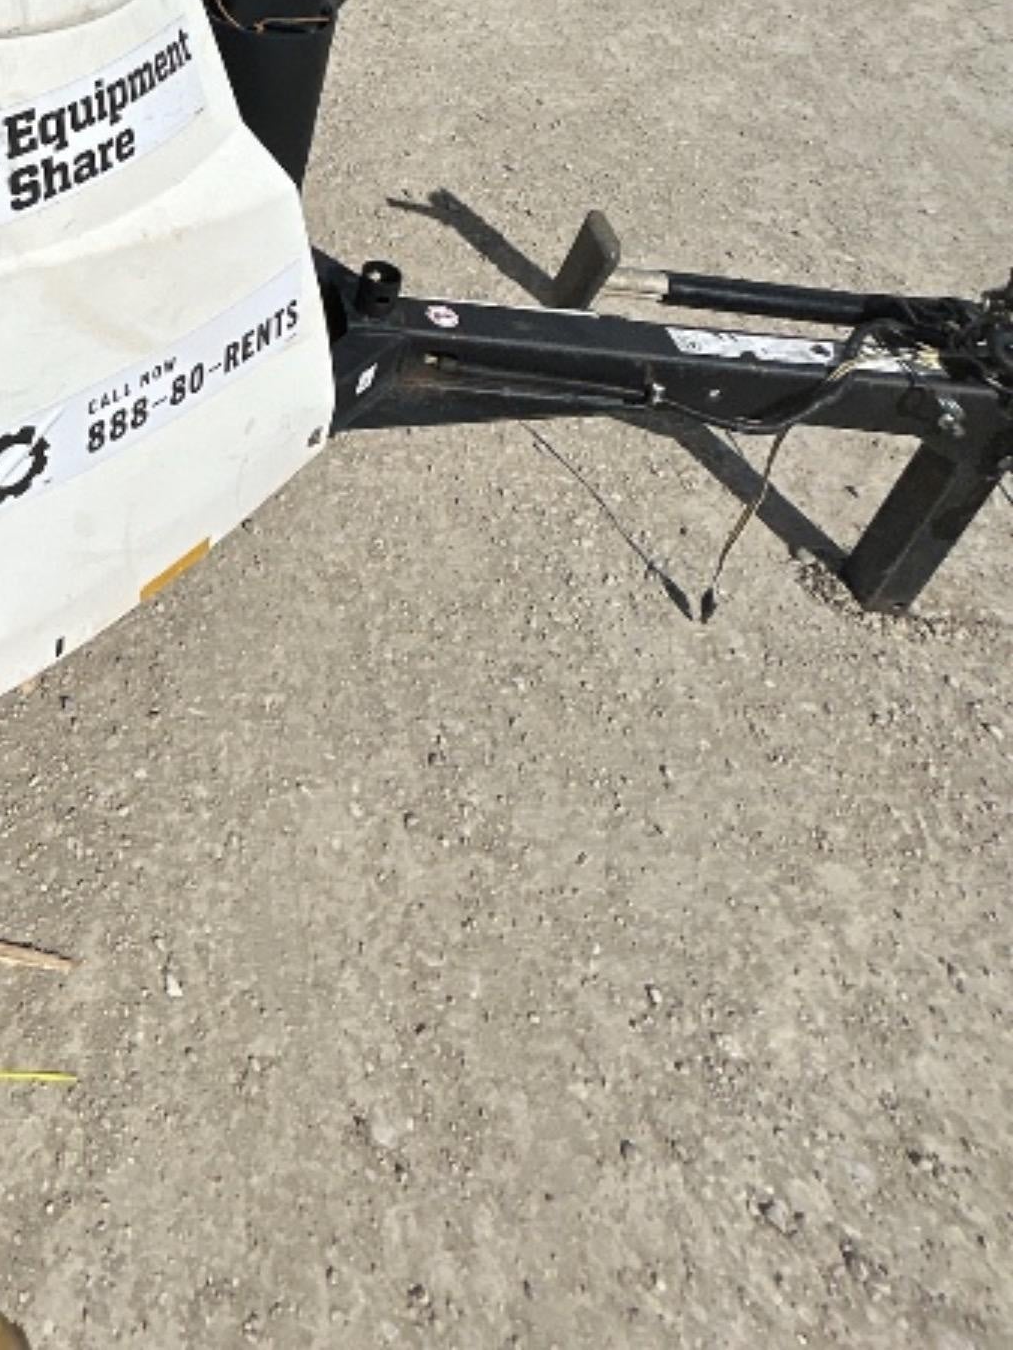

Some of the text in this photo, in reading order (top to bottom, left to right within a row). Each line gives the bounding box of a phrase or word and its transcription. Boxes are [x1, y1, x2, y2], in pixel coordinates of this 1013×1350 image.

[3, 28, 192, 159] Equipment
[8, 128, 136, 211] Share
[87, 299, 300, 454] 888-80-RENTS
[88, 356, 178, 415] CALL NOW
